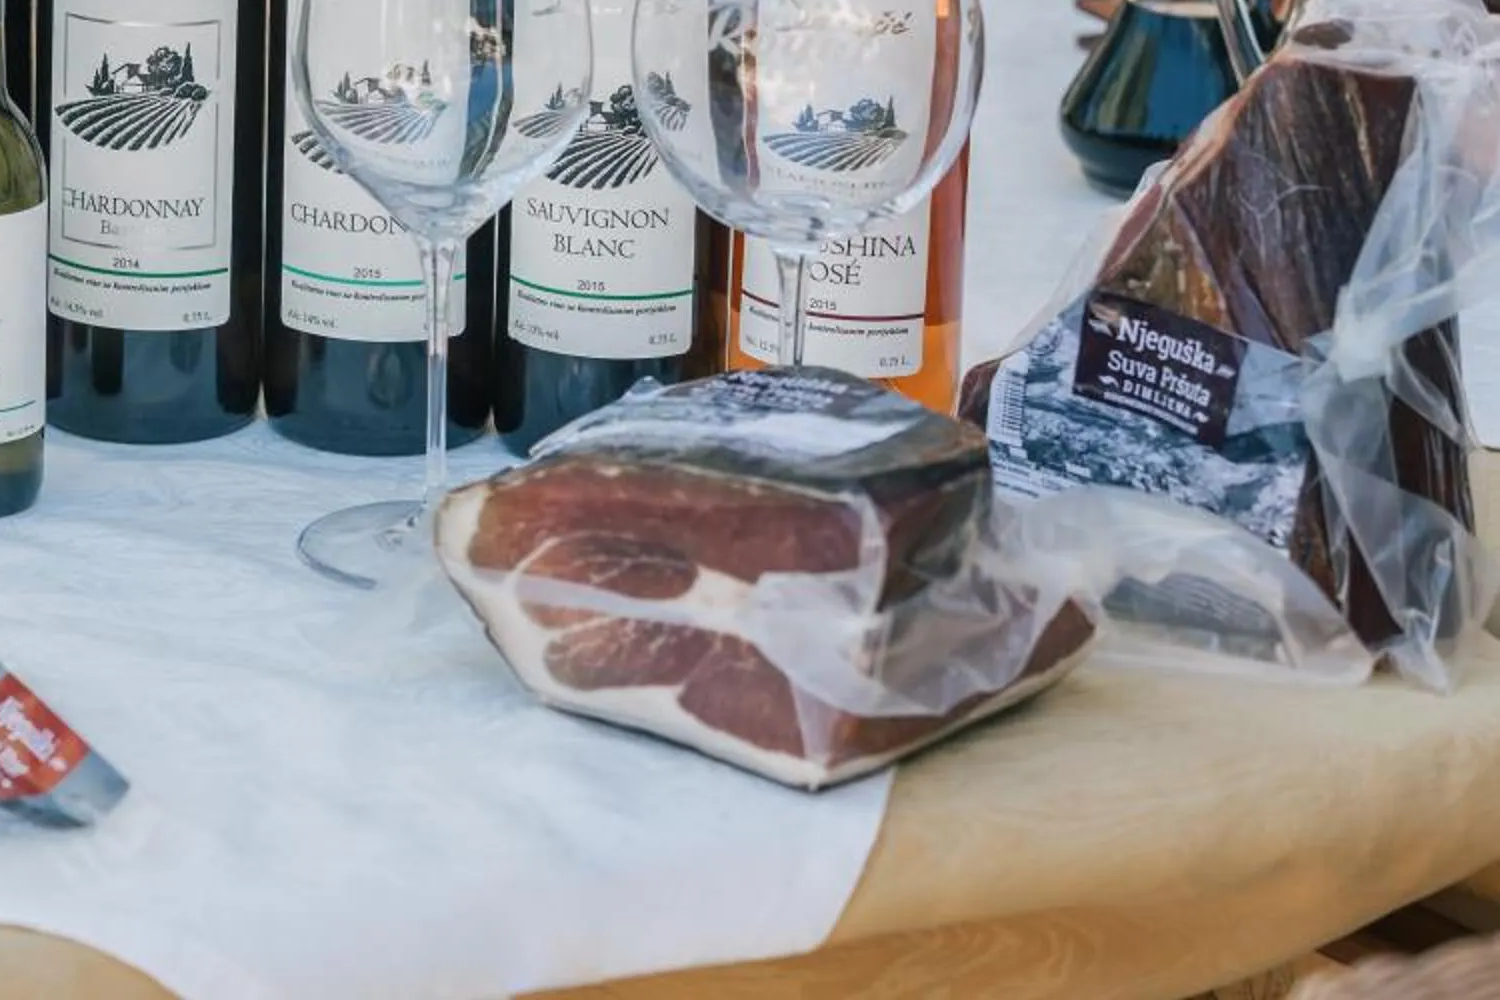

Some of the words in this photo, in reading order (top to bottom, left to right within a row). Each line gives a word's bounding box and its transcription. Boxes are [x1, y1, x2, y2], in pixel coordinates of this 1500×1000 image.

[62, 186, 205, 219] CHARDONNAY
[290, 202, 409, 236] CHARDON
[526, 198, 670, 230] SAUVIGNON
[553, 233, 636, 260] BLANC
[809, 257, 862, 287] OSÉ
[1115, 315, 1216, 375] Njeguška
[1107, 349, 1157, 384] Suva
[1159, 365, 1211, 408] Pršuta
